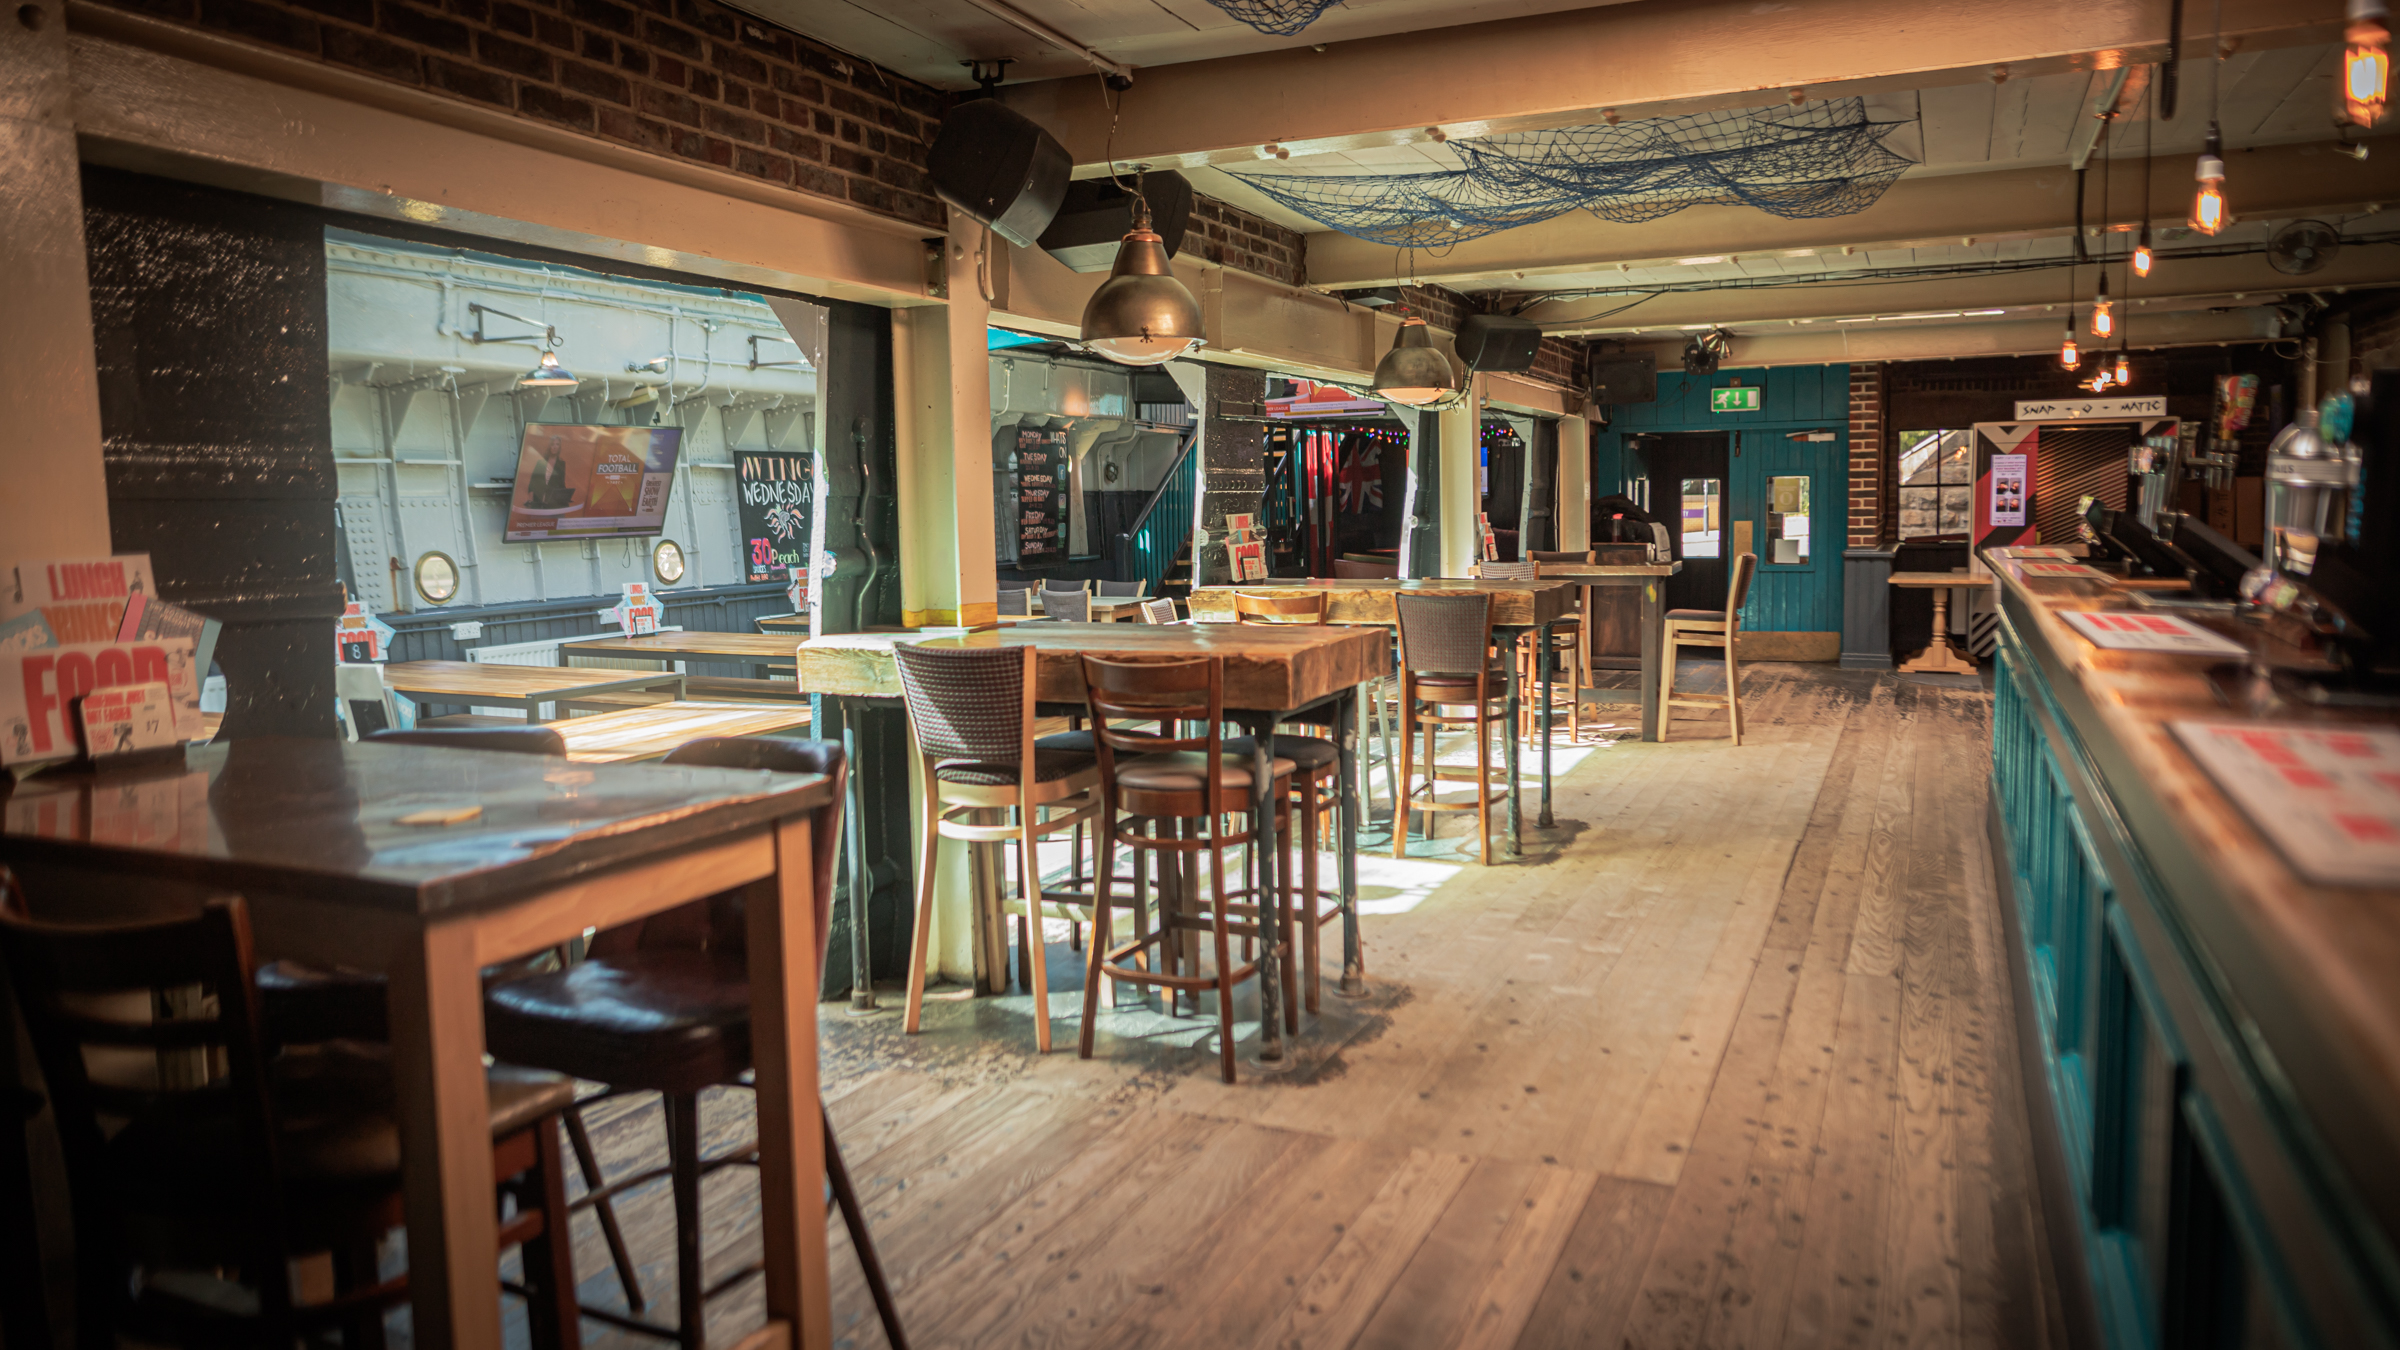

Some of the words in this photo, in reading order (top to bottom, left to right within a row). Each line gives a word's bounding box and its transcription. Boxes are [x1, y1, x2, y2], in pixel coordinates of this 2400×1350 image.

[2022, 404, 2056, 417] SNAP
[2120, 400, 2161, 412] MATIC
[608, 454, 631, 463] TOTAL
[1023, 452, 1047, 462] TUESDAY
[598, 464, 637, 473] FOOTBALL
[746, 456, 811, 481] WING
[1023, 474, 1053, 484] WEDNESDAY
[1024, 489, 1050, 498] THURSDAY
[1025, 541, 1043, 550] SUNDAY
[779, 549, 800, 564] each
[47, 562, 128, 601] LUNCH
[352, 643, 362, 660] 8
